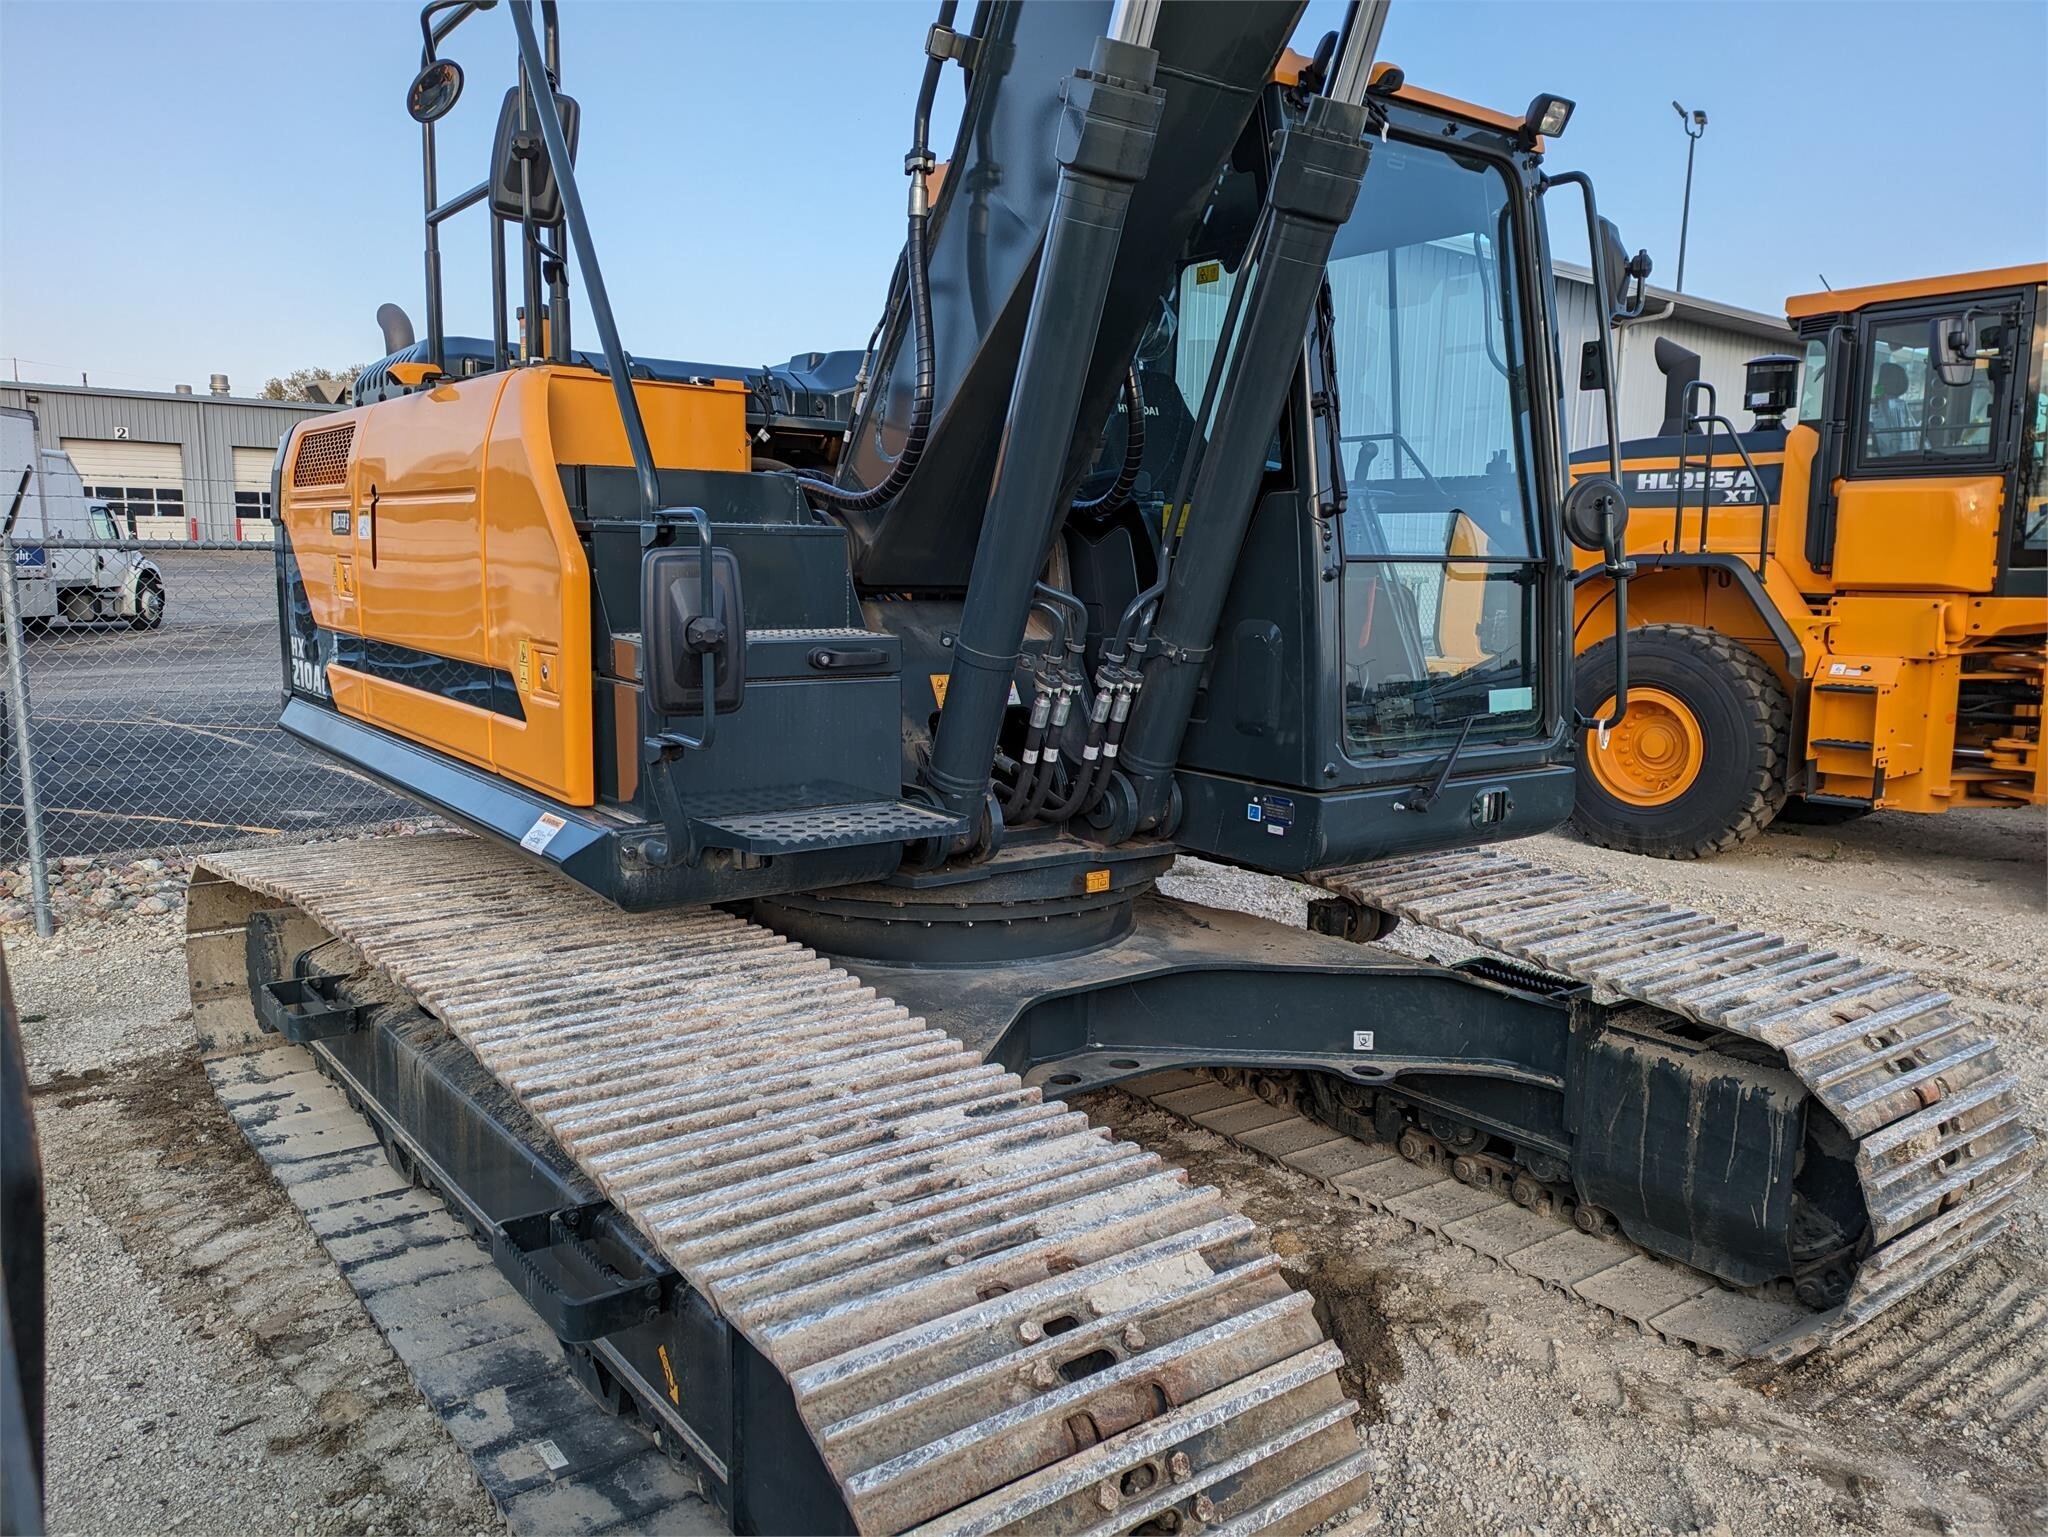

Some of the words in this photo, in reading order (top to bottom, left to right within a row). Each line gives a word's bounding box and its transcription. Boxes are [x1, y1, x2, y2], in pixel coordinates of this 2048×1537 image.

[117, 427, 127, 439] 2
[1637, 470, 1756, 490] HL955A
[1723, 489, 1756, 503] XT
[291, 635, 305, 659] HX
